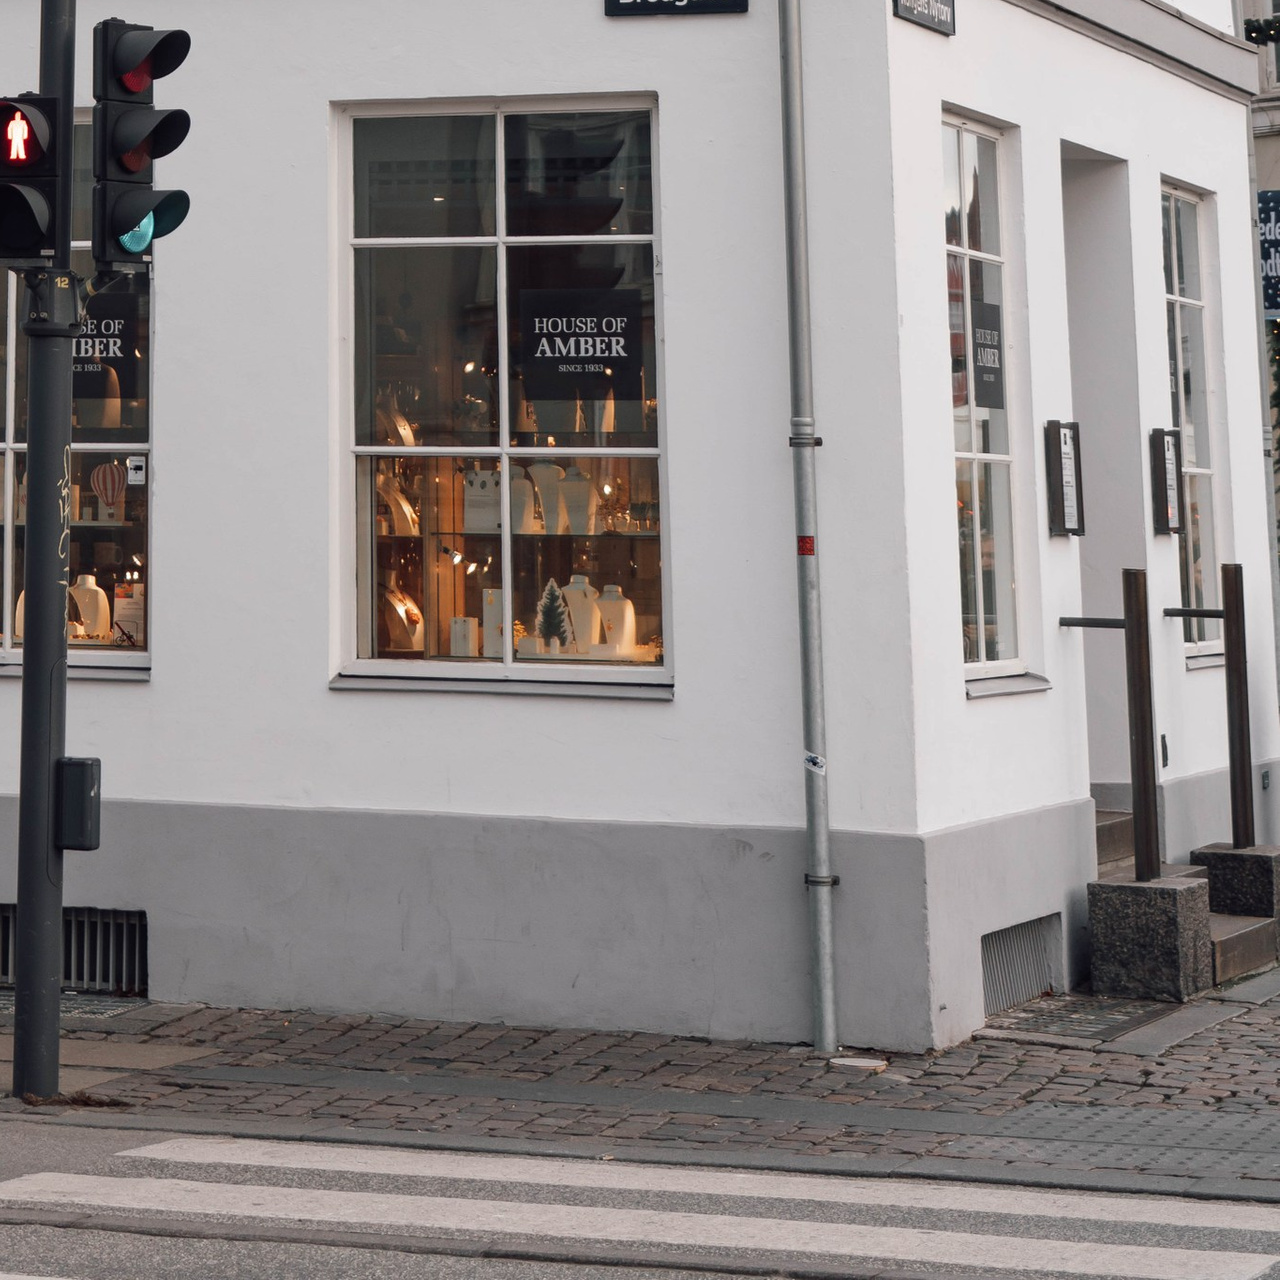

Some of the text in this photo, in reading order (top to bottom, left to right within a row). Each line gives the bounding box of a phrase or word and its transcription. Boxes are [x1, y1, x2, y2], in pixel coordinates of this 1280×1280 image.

[55, 276, 69, 288] 12
[101, 319, 124, 335] OF
[533, 317, 628, 333] HOUSE OF
[72, 338, 124, 358] BER
[534, 336, 628, 357] AMBER
[84, 363, 102, 372] 1933
[558, 364, 604, 372] SINCE 1933
